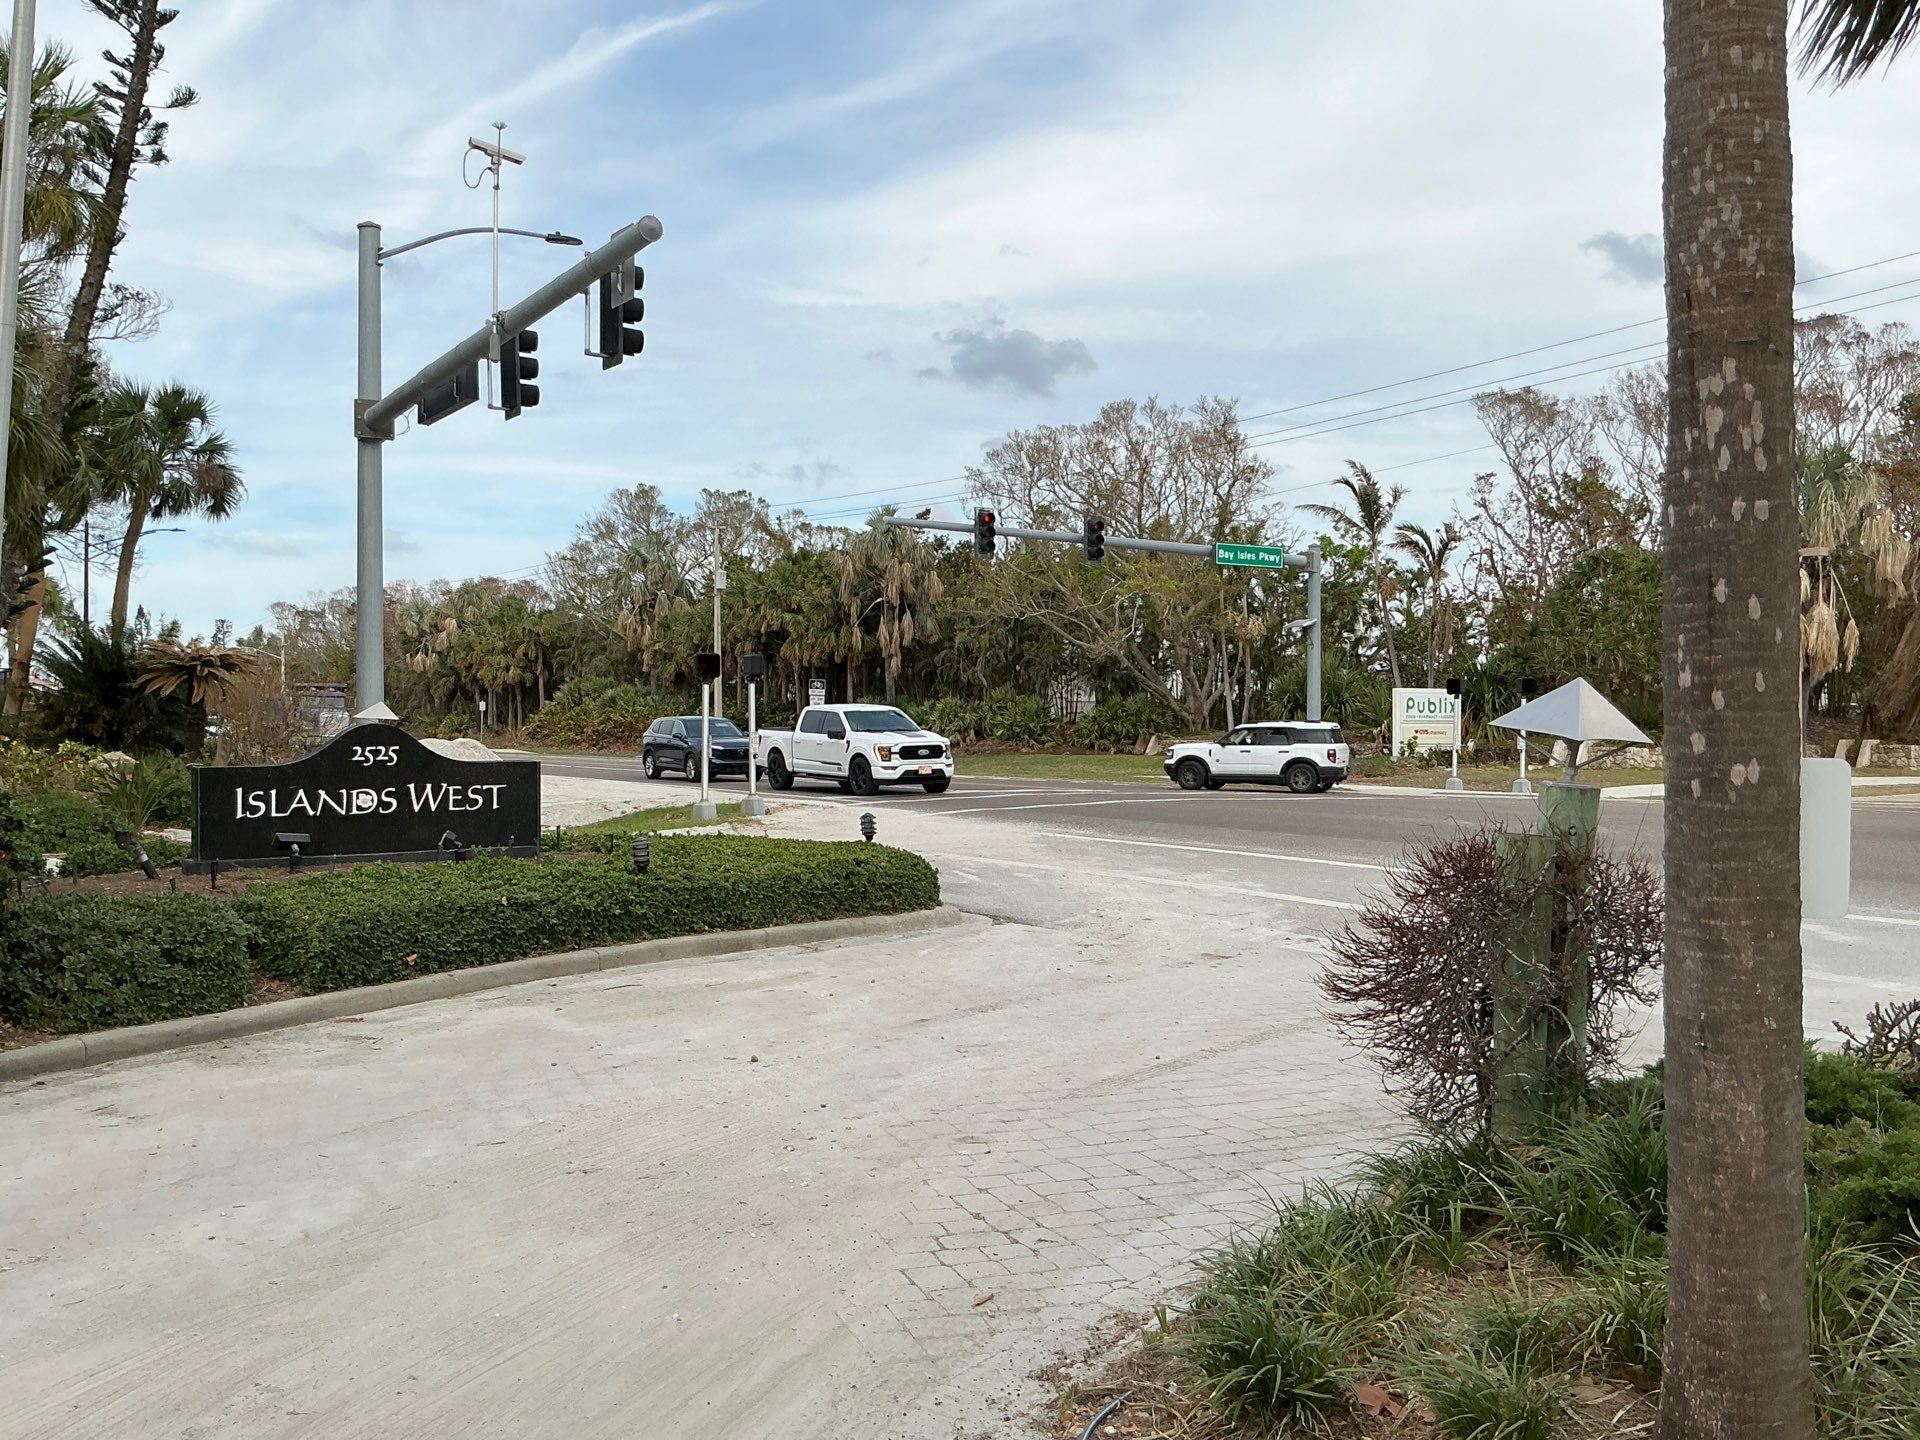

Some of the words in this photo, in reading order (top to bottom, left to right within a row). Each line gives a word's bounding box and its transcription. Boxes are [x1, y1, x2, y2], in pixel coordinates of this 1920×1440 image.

[1218, 549, 1234, 561] Bay
[1237, 550, 1256, 560] Isles
[1259, 552, 1280, 563] Pkwy
[1406, 696, 1455, 713] Publix
[352, 745, 400, 766] 2525
[235, 787, 398, 819] ISLANDS
[407, 782, 507, 813] WEST
